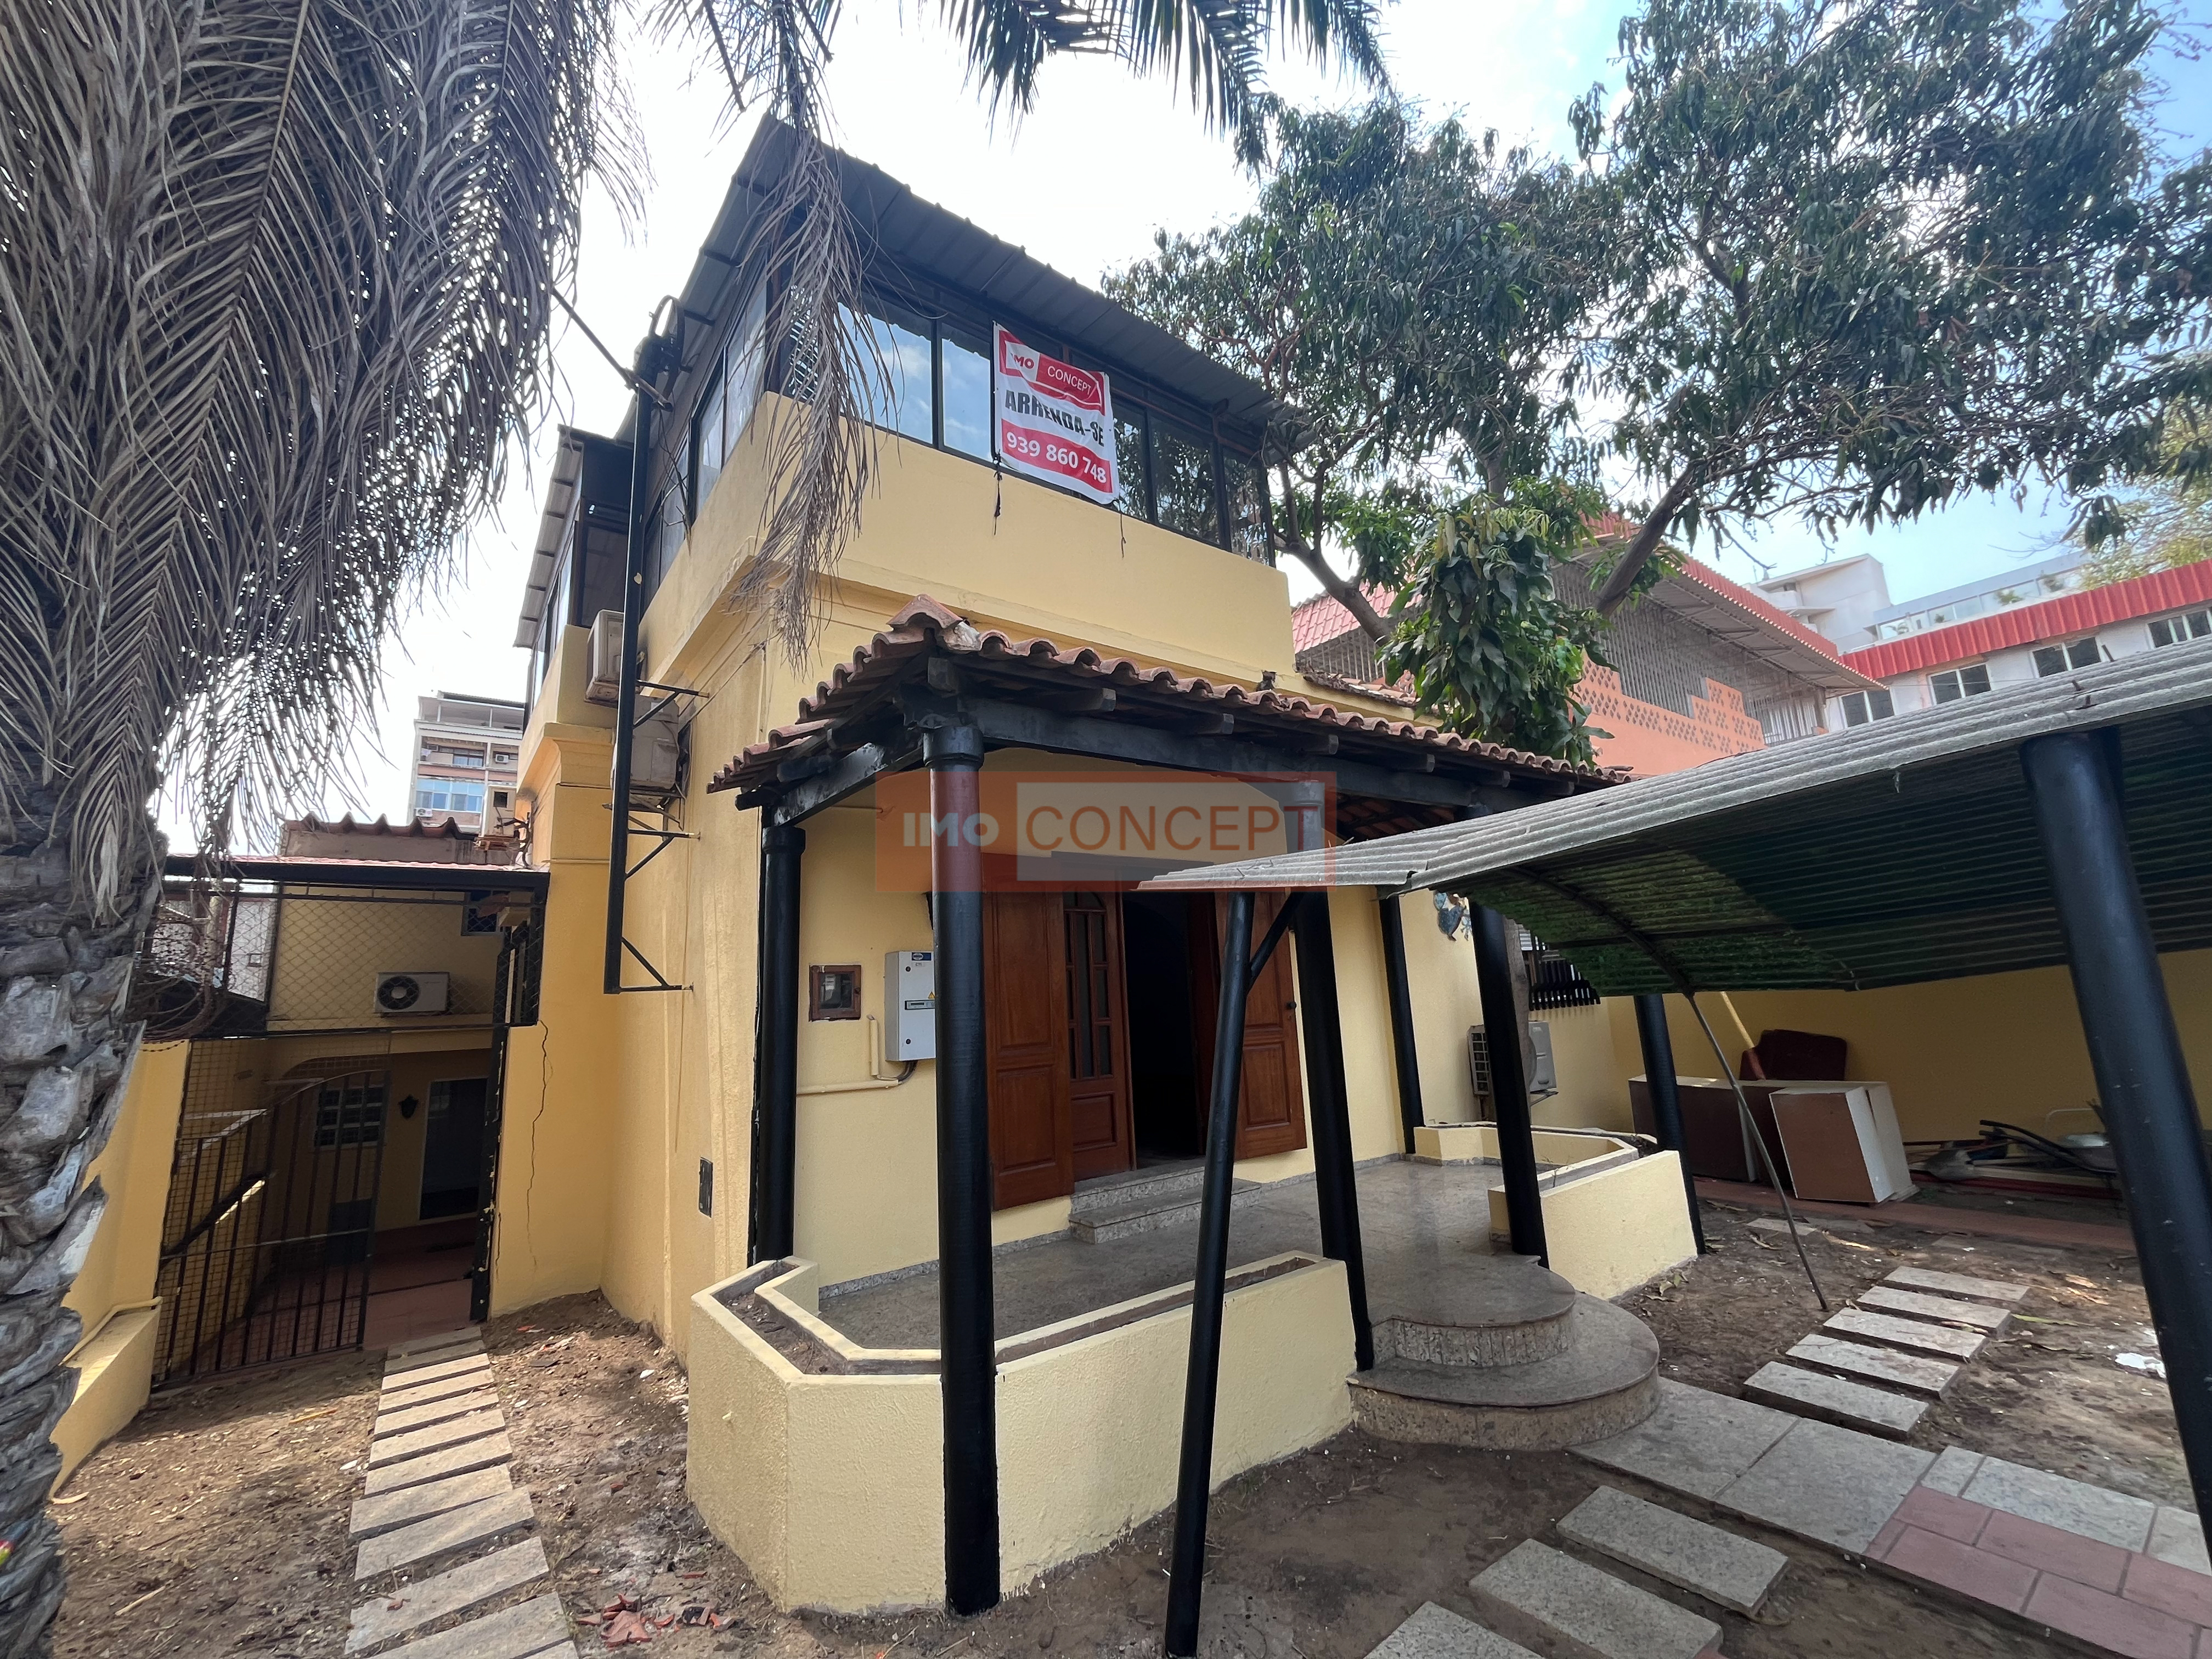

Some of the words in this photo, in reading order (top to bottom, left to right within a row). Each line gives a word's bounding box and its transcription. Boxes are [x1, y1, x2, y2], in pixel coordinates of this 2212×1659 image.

[1011, 353, 1034, 369] MO
[1047, 366, 1091, 395] CONCEPT
[1005, 390, 1104, 447] ARRENDA-SE
[1007, 432, 1040, 457] 939
[1046, 444, 1079, 469] 860
[1082, 456, 1107, 483] 748
